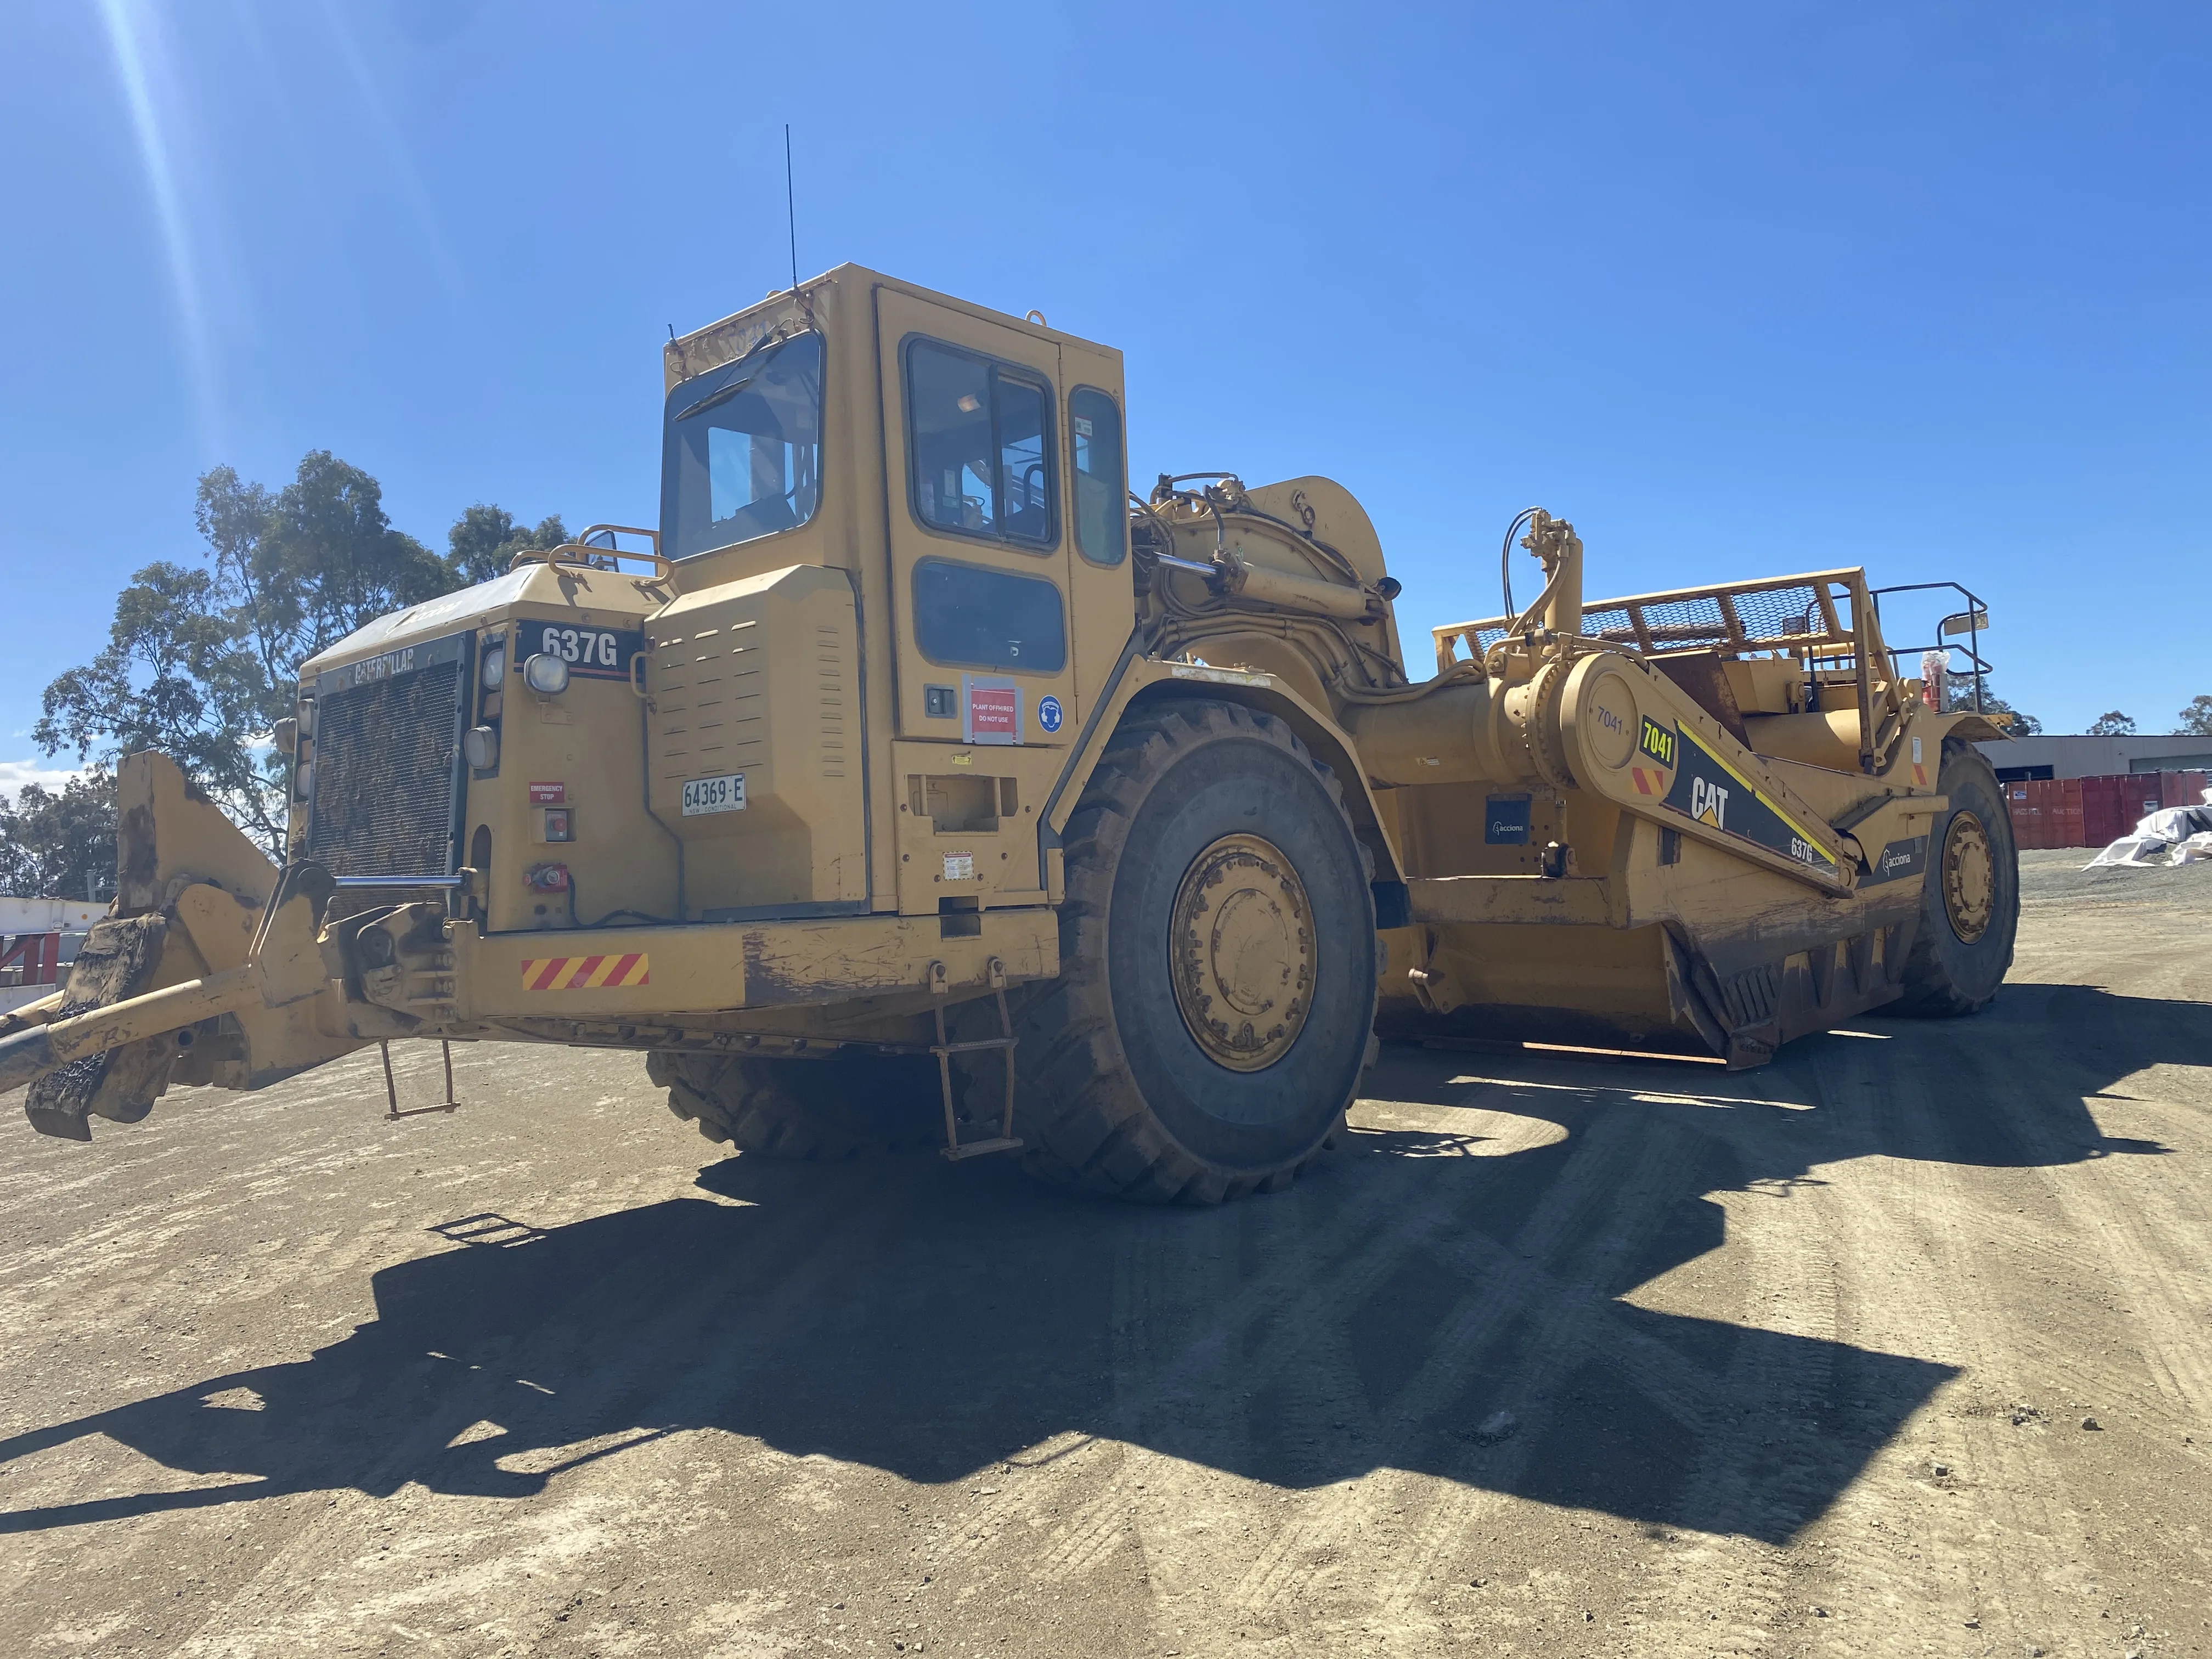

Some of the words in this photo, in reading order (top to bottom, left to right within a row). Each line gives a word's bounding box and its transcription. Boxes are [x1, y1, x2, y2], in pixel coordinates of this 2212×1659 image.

[543, 627, 617, 666] 637G
[1597, 706, 1622, 735] 7041
[1644, 721, 1672, 763] 7041
[704, 803, 737, 812] CONDITIONAL
[1691, 776, 1729, 831] CAT
[1791, 837, 1813, 863] 637G
[1889, 853, 1911, 868] acciona
